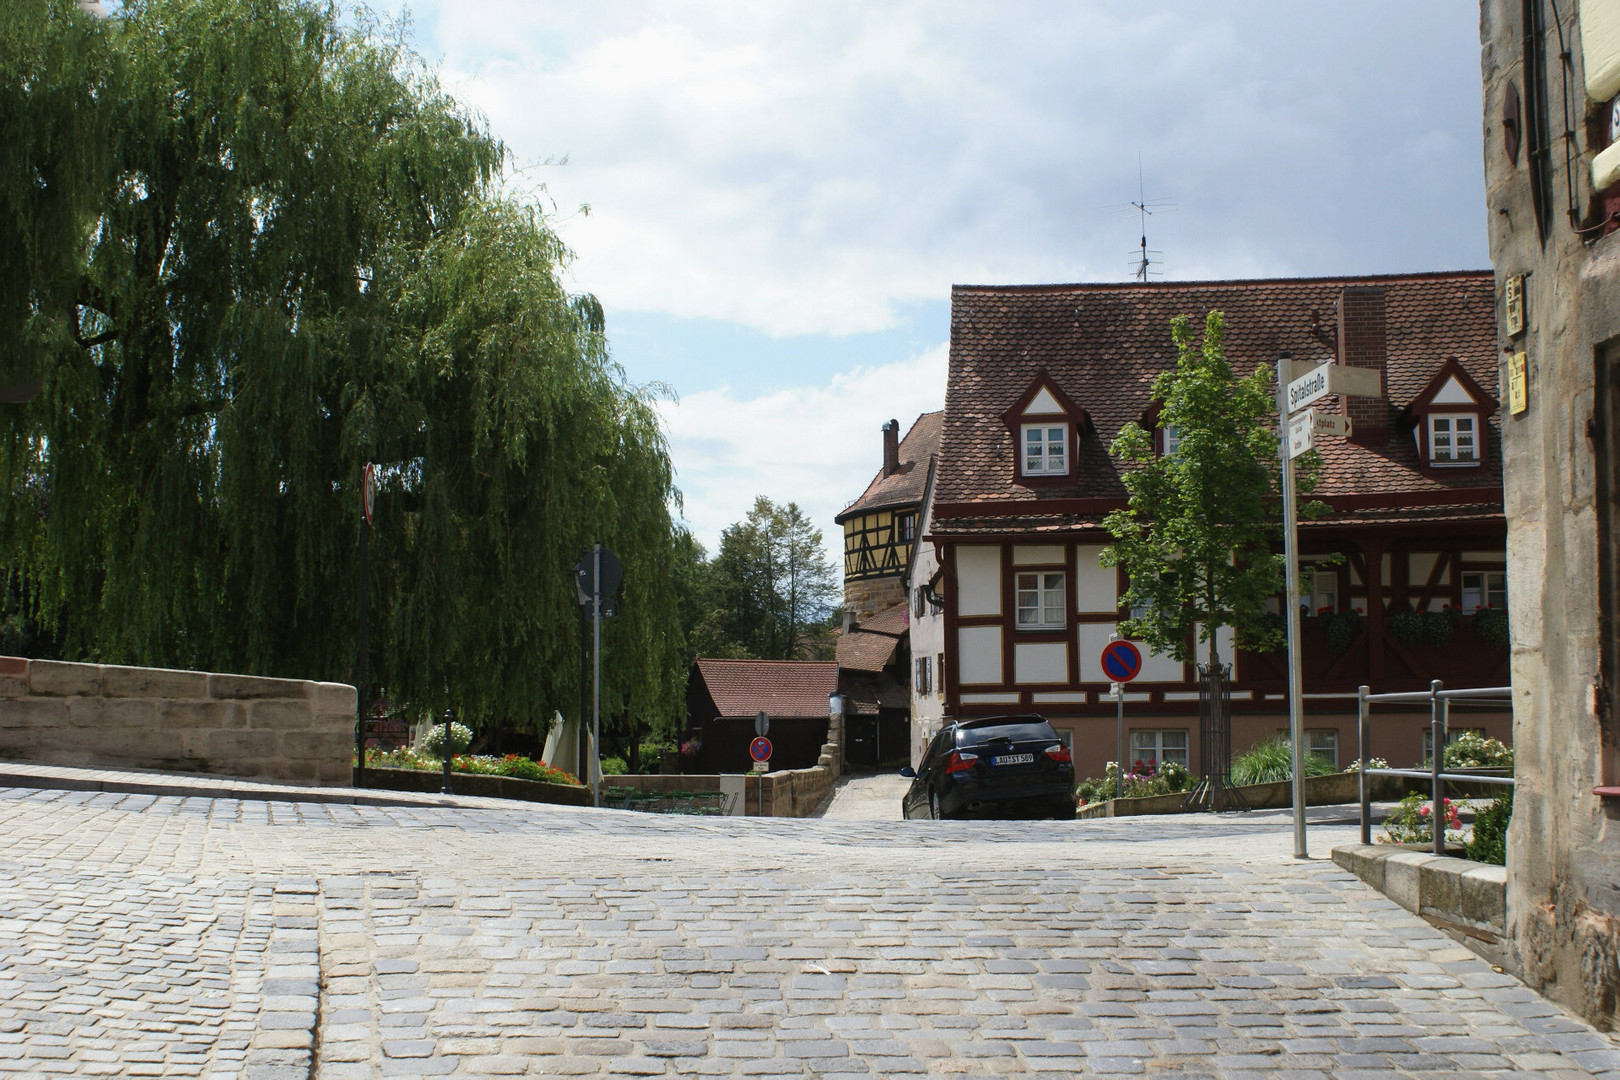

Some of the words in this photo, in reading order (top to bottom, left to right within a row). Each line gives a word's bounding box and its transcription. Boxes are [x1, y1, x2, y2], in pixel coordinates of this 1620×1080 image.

[1291, 372, 1324, 408] Spitalstraße
[995, 755, 1008, 765] LAU
[1012, 754, 1020, 763] ST
